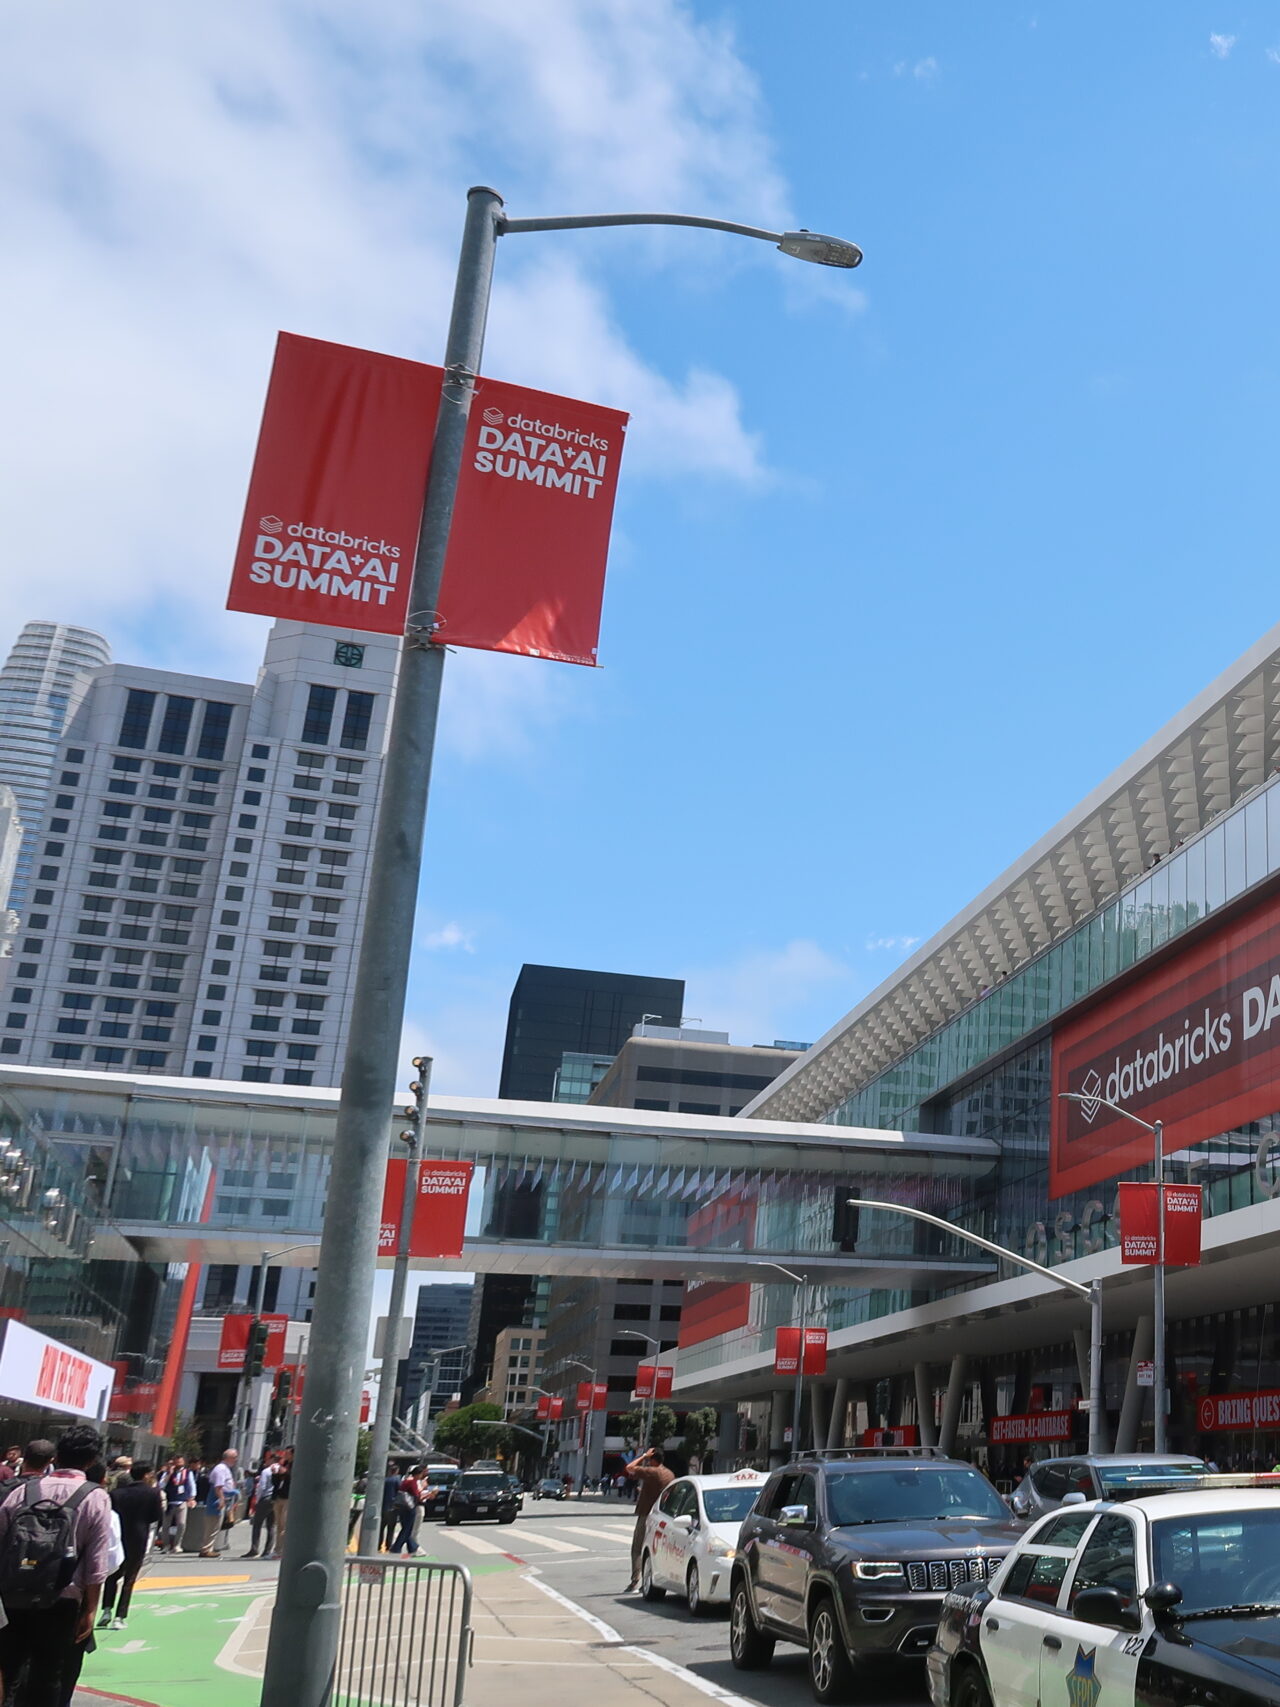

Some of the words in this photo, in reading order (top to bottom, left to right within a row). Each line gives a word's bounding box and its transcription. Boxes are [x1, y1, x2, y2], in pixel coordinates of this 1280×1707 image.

[508, 413, 608, 451] databricks
[473, 450, 602, 499] SUMMIT
[287, 522, 400, 558] databricks
[249, 561, 395, 605] SUMMIT
[1105, 1007, 1233, 1105] databricks
[421, 1186, 464, 1194] SUMMIT
[1166, 1204, 1199, 1213] SUMMIT
[1124, 1249, 1157, 1257] SUMMIT
[1218, 1397, 1251, 1425] BRING
[734, 1473, 758, 1481] TAXI
[1121, 1635, 1145, 1657] 122
